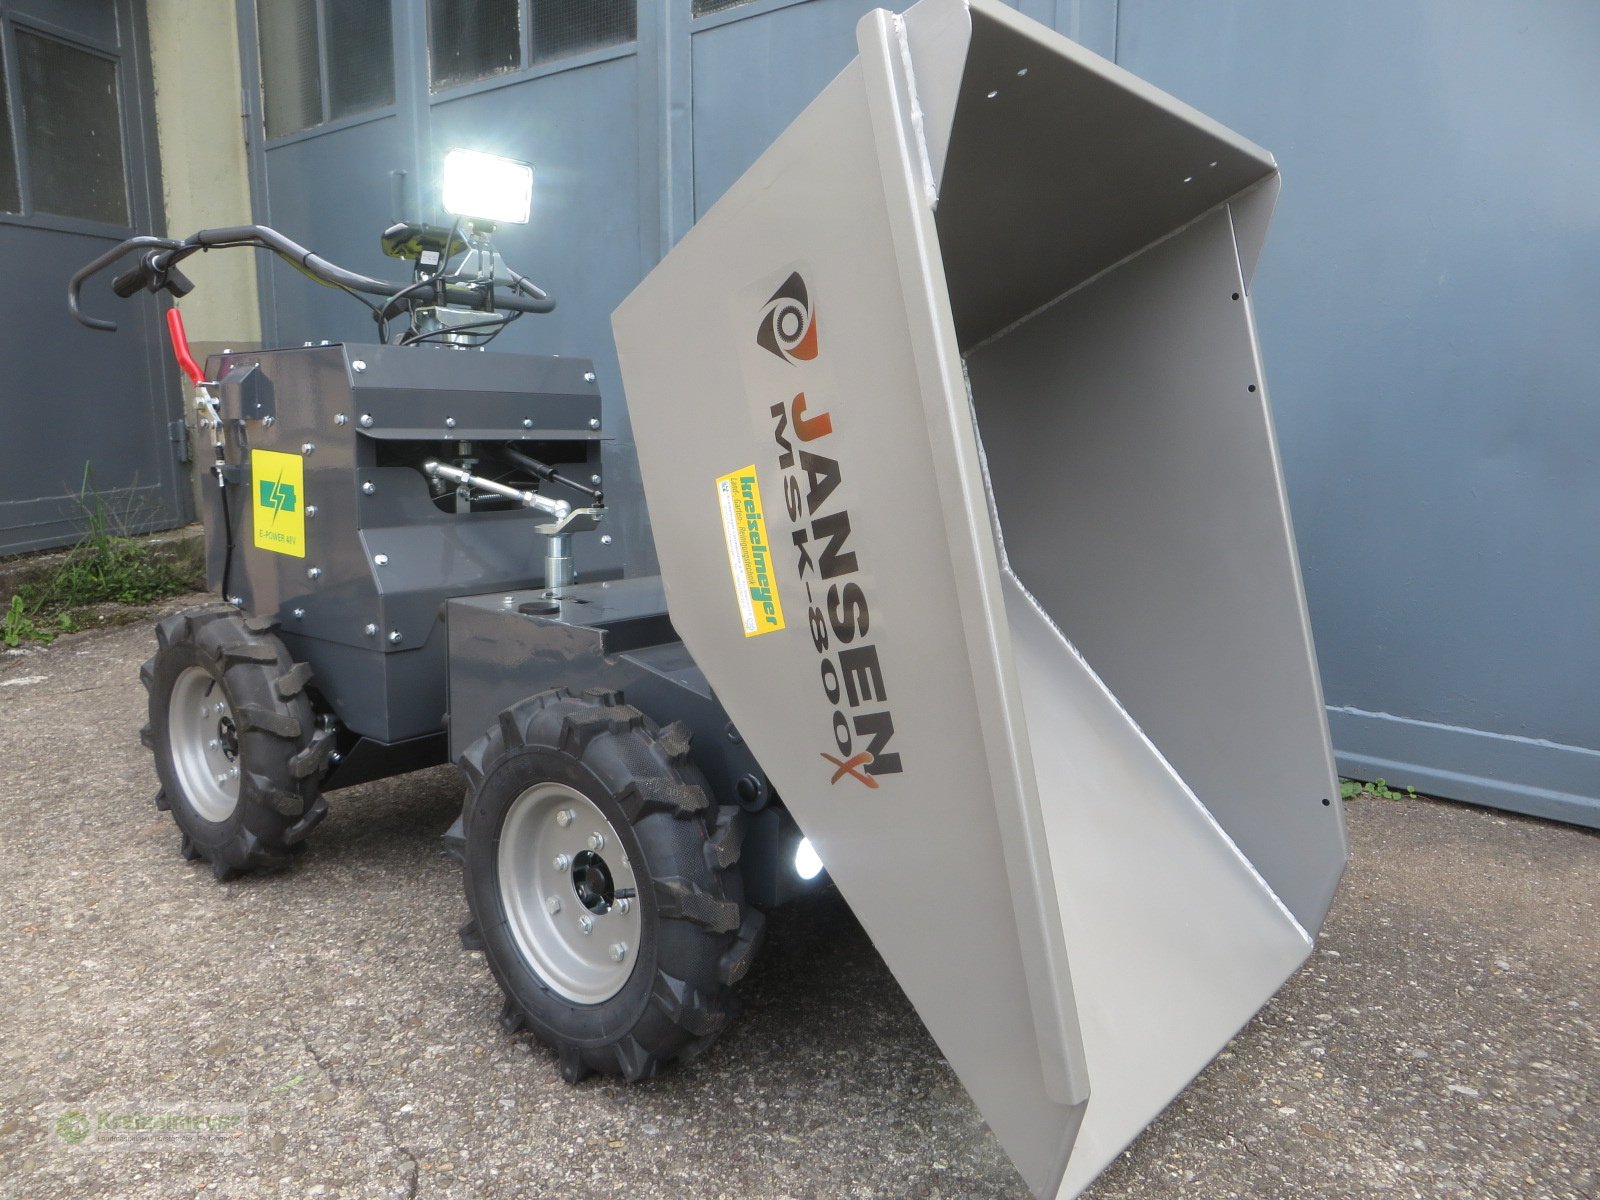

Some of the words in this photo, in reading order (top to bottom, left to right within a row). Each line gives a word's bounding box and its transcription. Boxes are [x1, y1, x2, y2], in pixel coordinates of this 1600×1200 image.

[259, 529, 285, 542] E-POWER
[739, 526, 756, 585] Reinigungstechnik
[740, 477, 777, 625] kreiselmeyer
[792, 392, 903, 775] JANSEN
